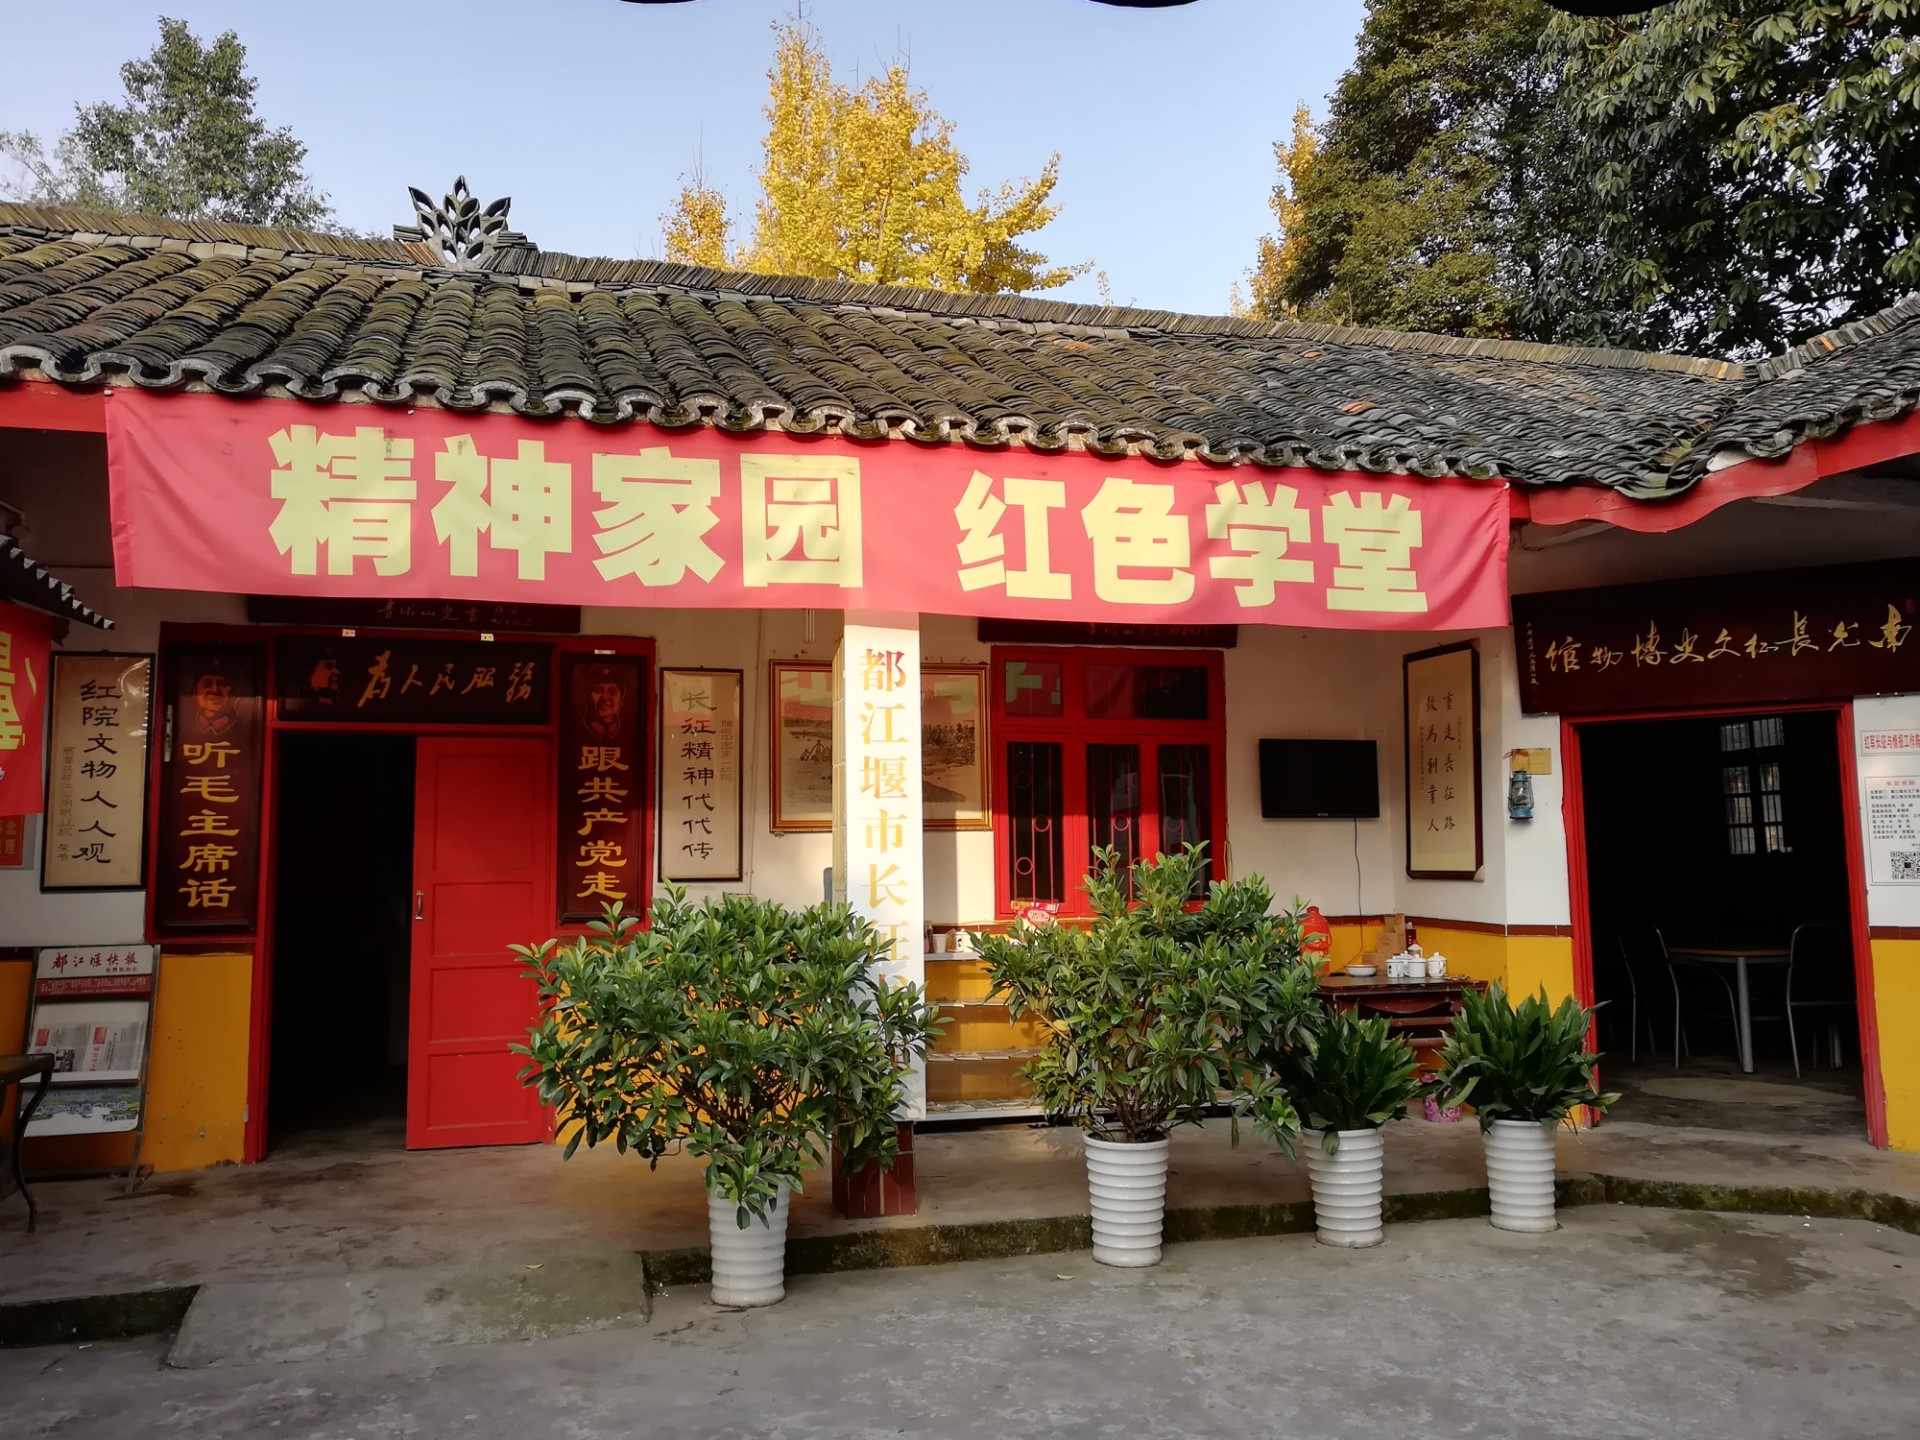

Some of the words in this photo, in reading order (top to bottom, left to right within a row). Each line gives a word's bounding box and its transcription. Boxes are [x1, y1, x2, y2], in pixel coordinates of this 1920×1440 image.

[268, 424, 863, 588] 精神家园
[954, 469, 1429, 613] 红色学堂
[72, 678, 122, 864] 红院文物人人观
[178, 741, 241, 909] 听毛主席话
[576, 745, 629, 900] 跟共产党走
[680, 691, 717, 861] 长征精神代代传
